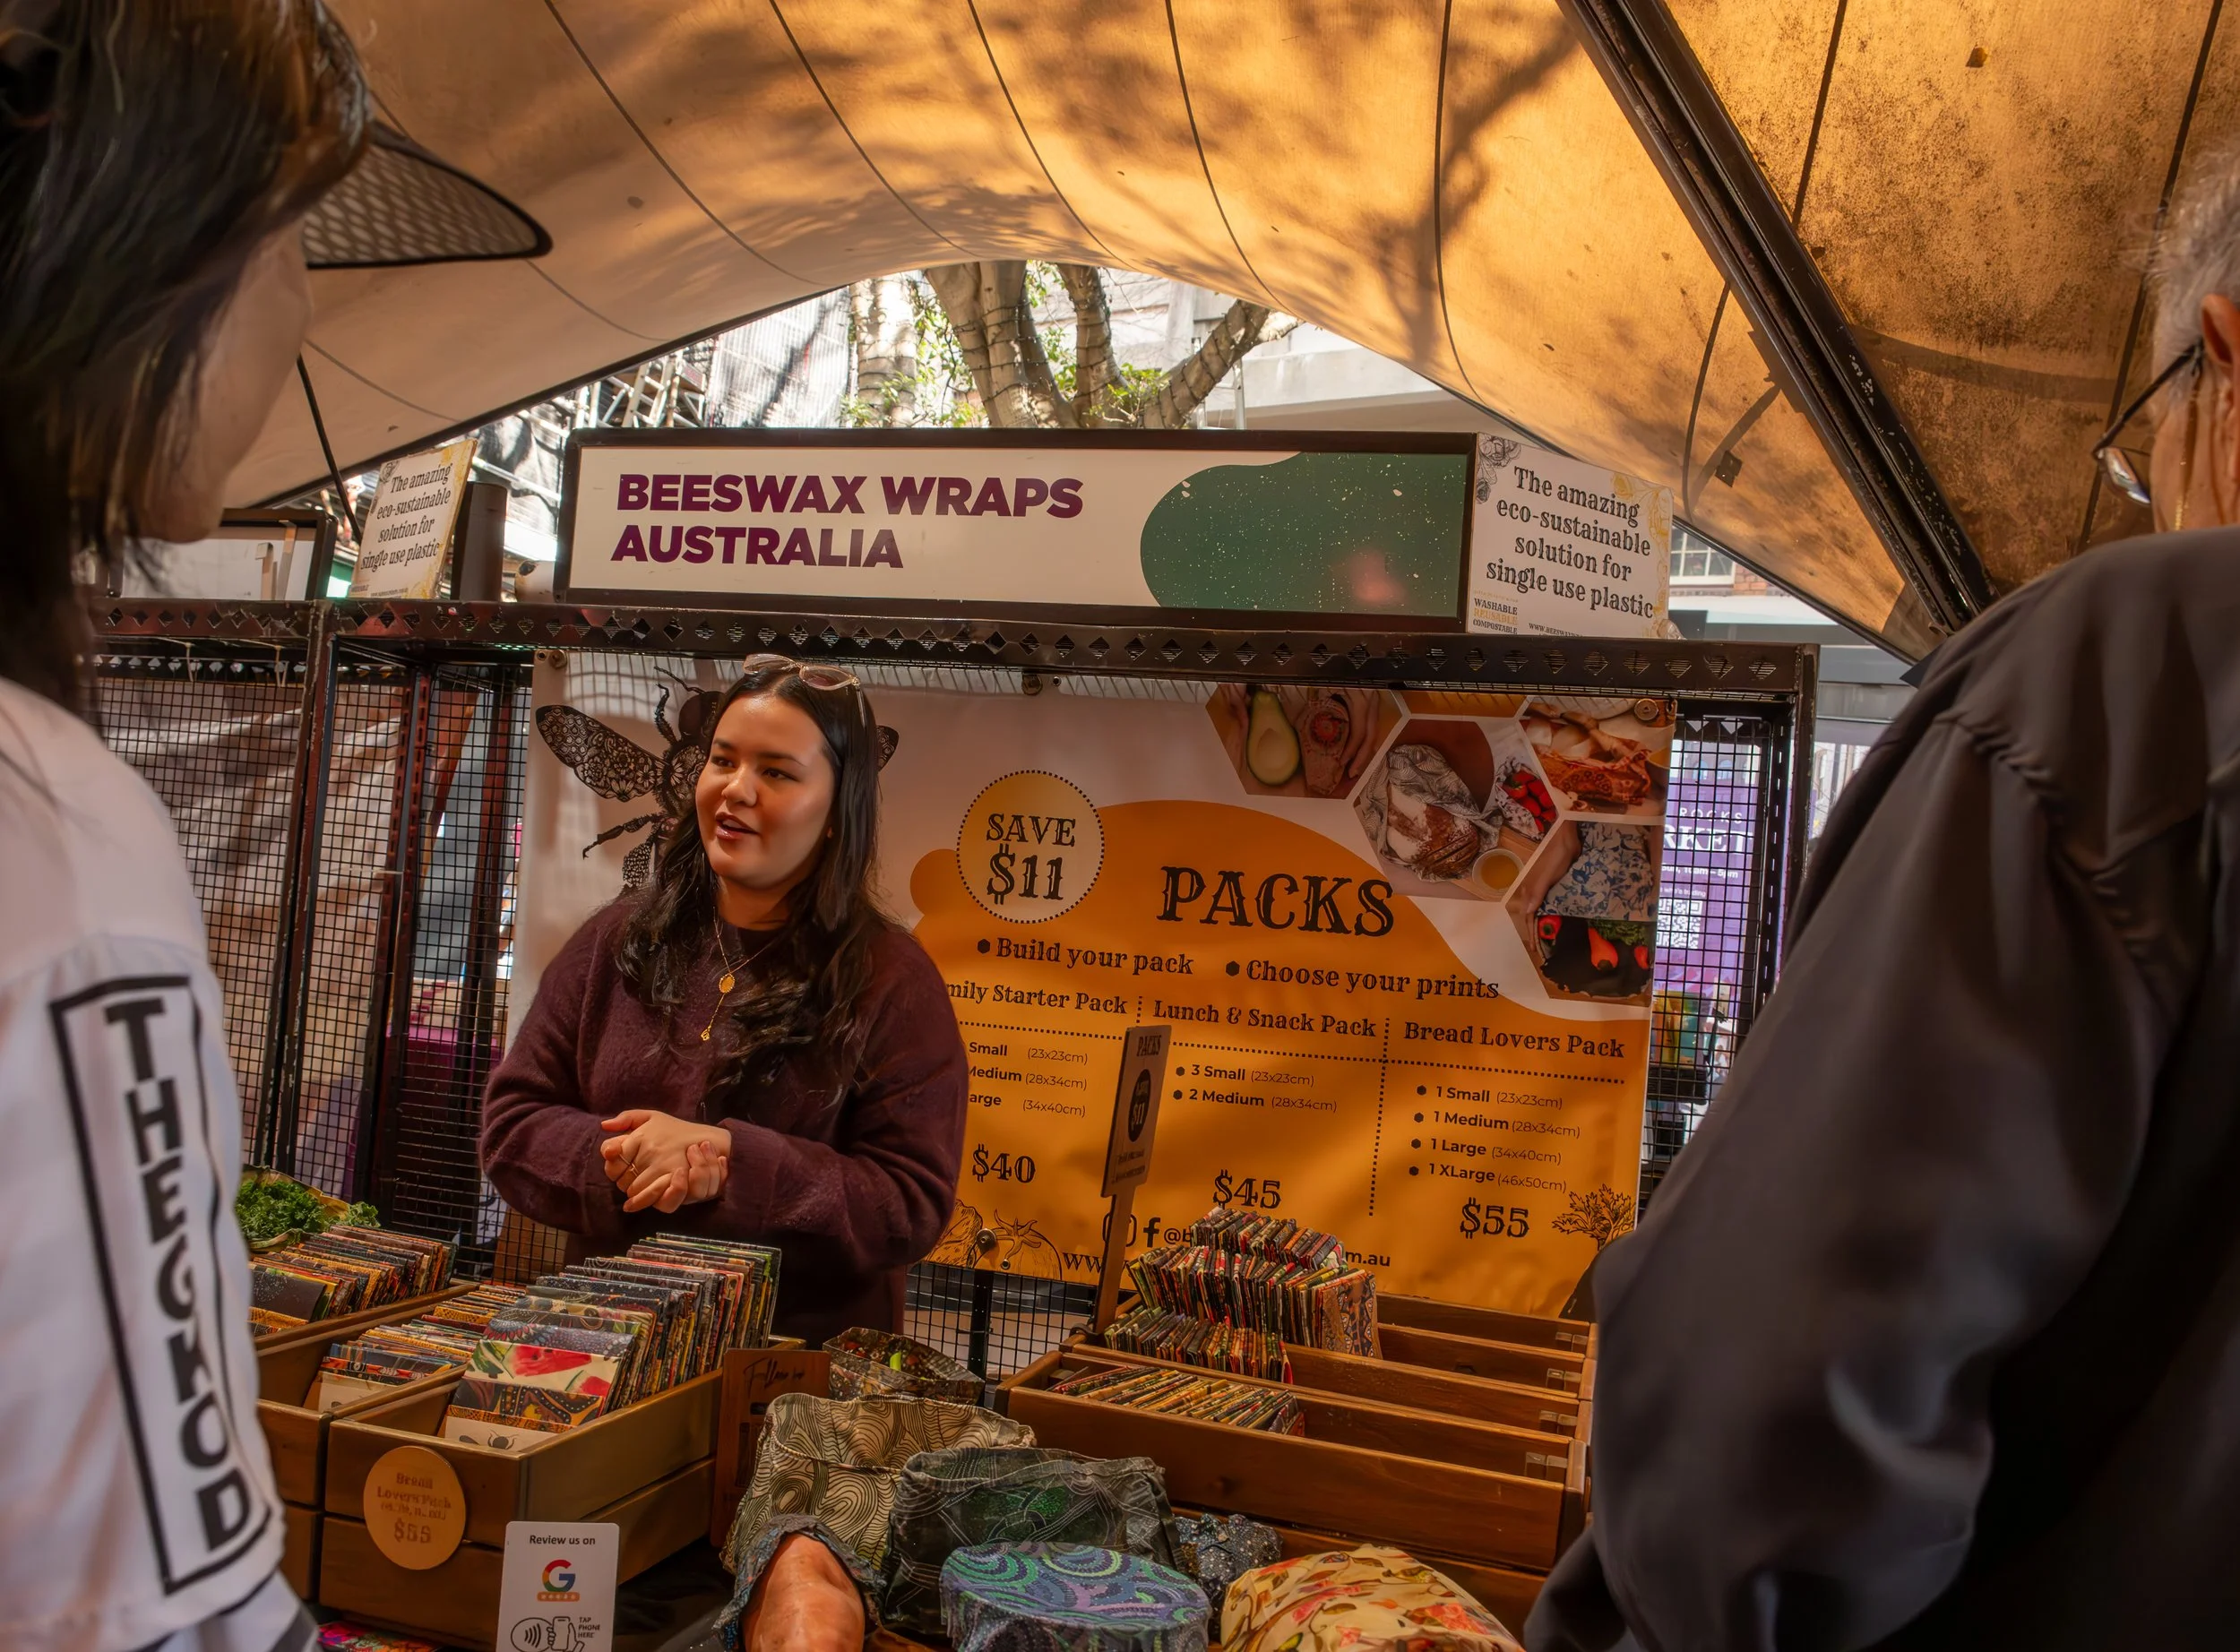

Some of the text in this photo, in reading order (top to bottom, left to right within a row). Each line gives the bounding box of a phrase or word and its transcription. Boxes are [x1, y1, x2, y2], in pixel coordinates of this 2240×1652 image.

[390, 463, 453, 493] The amazing
[377, 488, 452, 520] eco-sustainable
[617, 474, 1083, 519] BEESWAX WRAPS
[1514, 465, 1640, 528] The amazing
[377, 515, 435, 543] solution for
[1497, 500, 1650, 556] eco-sustainable
[360, 538, 440, 572] single use plastic
[611, 525, 903, 568] AUSTRALIA
[1515, 537, 1632, 581] solution for
[1486, 558, 1547, 593] single
[1553, 578, 1586, 602] use
[1590, 587, 1653, 618] plastic
[1474, 598, 1518, 615] WASHABLE
[1473, 618, 1518, 634] COMPOSTABLE
[986, 813, 1077, 848] SAVE
[986, 843, 1064, 905] $11
[1156, 865, 1395, 938] PACKS
[996, 937, 1194, 977] Build your pack
[1246, 959, 1500, 1000] Choose your prints
[993, 985, 1070, 1008] Starter
[1075, 992, 1128, 1014] Pack
[1153, 1000, 1376, 1037] Lunch & Snack Pack
[969, 1042, 1088, 1066] Small (23x23cm)
[1136, 1035, 1162, 1056] PACKS
[1404, 1021, 1624, 1059] Bread Lovers Pack
[1025, 1073, 1087, 1091] (28x34cm)
[1191, 1064, 1314, 1088] 3 Small (23x23cm)
[969, 1093, 1086, 1118] arge (34x40cm)
[1189, 1088, 1338, 1114] 2 Medium (28x34cm)
[1436, 1086, 1563, 1110] 1 Small (23x23cm)
[1434, 1111, 1581, 1140] 1 Medium (28x34cm)
[972, 1143, 1036, 1183] $40
[1431, 1138, 1562, 1166] 1 Large (34x40cm)
[1212, 1170, 1281, 1209] $45
[1428, 1163, 1567, 1193] 1 XLarge (46x50cm)
[1460, 1197, 1529, 1239] $55
[530, 1535, 596, 1544] Review us on
[542, 1559, 576, 1592] G
